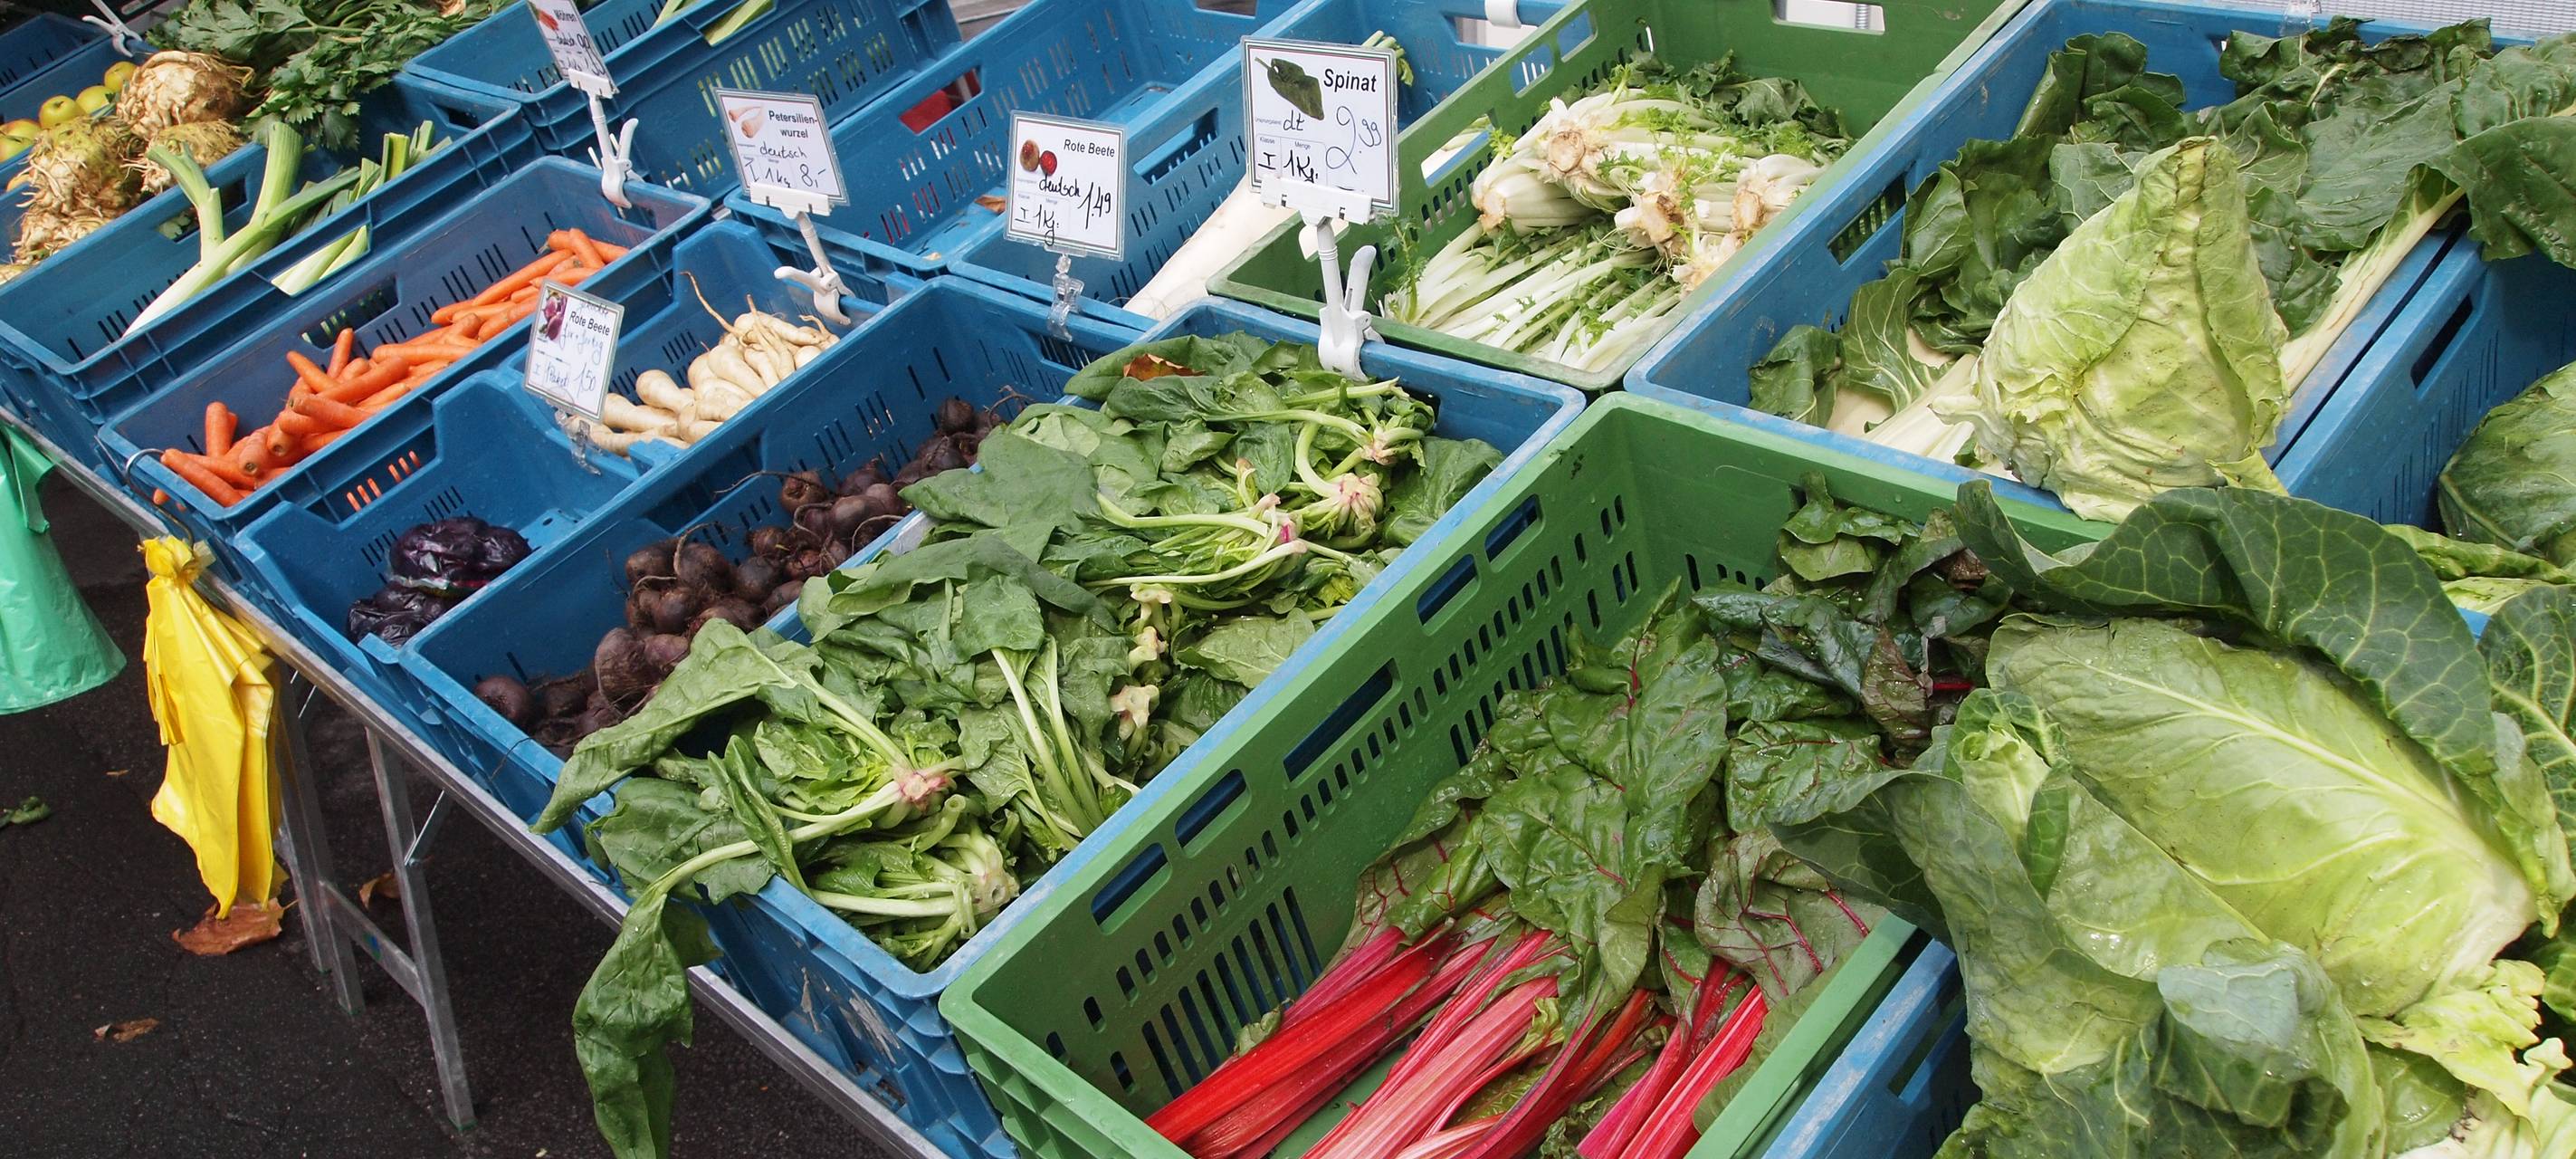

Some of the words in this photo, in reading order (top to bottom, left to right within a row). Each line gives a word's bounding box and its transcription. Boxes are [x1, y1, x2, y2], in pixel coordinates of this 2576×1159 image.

[1323, 68, 1377, 92] Spinat
[768, 110, 818, 124] Petersilien-
[1283, 110, 1305, 131] dt
[780, 129, 808, 139] wurzel
[759, 140, 807, 159] deutsch
[1064, 139, 1085, 153] Rote
[1088, 143, 1115, 158] Beete
[1038, 172, 1081, 197] deutsch
[569, 311, 587, 327] Rote
[587, 318, 610, 336] Beete
